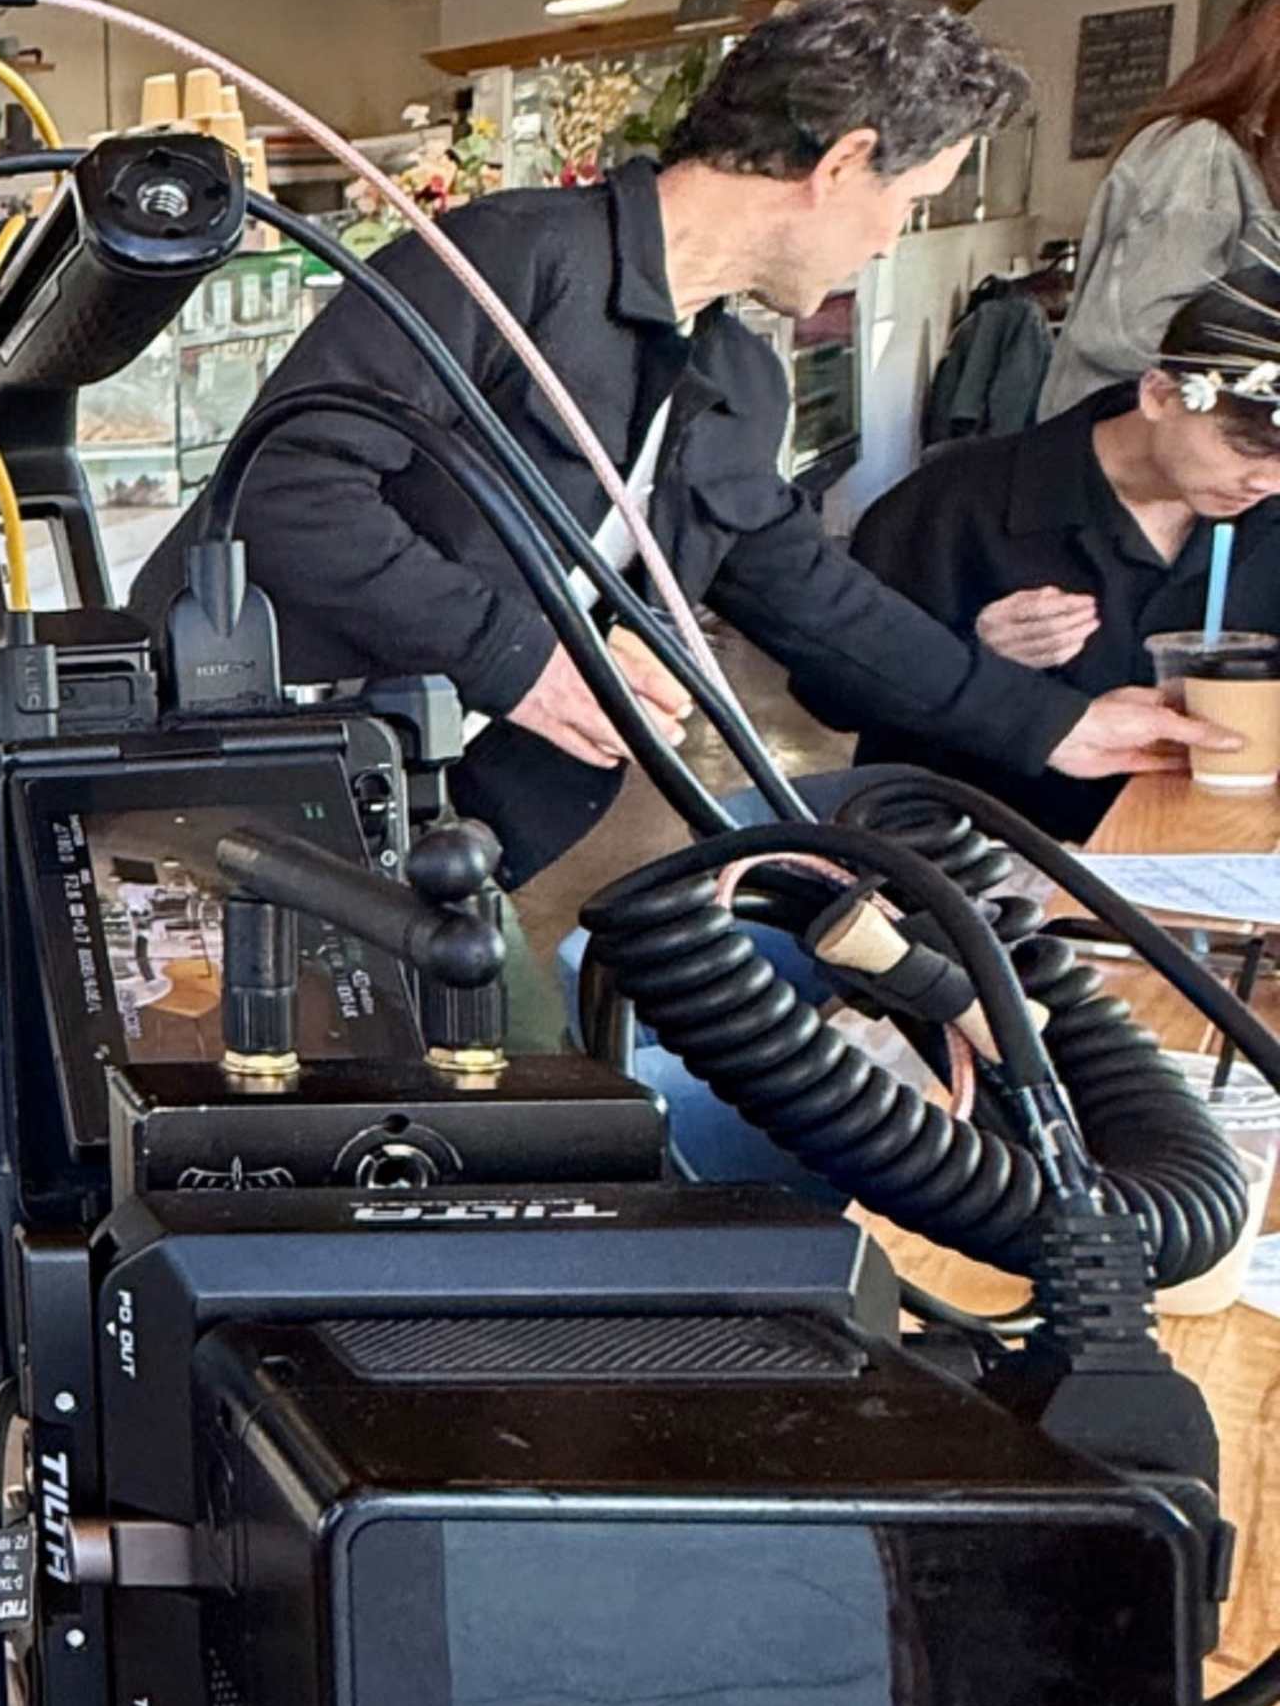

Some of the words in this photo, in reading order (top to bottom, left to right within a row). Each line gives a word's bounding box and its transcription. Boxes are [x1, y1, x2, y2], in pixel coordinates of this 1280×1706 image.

[118, 1290, 133, 1324] PD
[120, 1329, 136, 1380] OUT
[42, 1451, 72, 1584] TILTA
